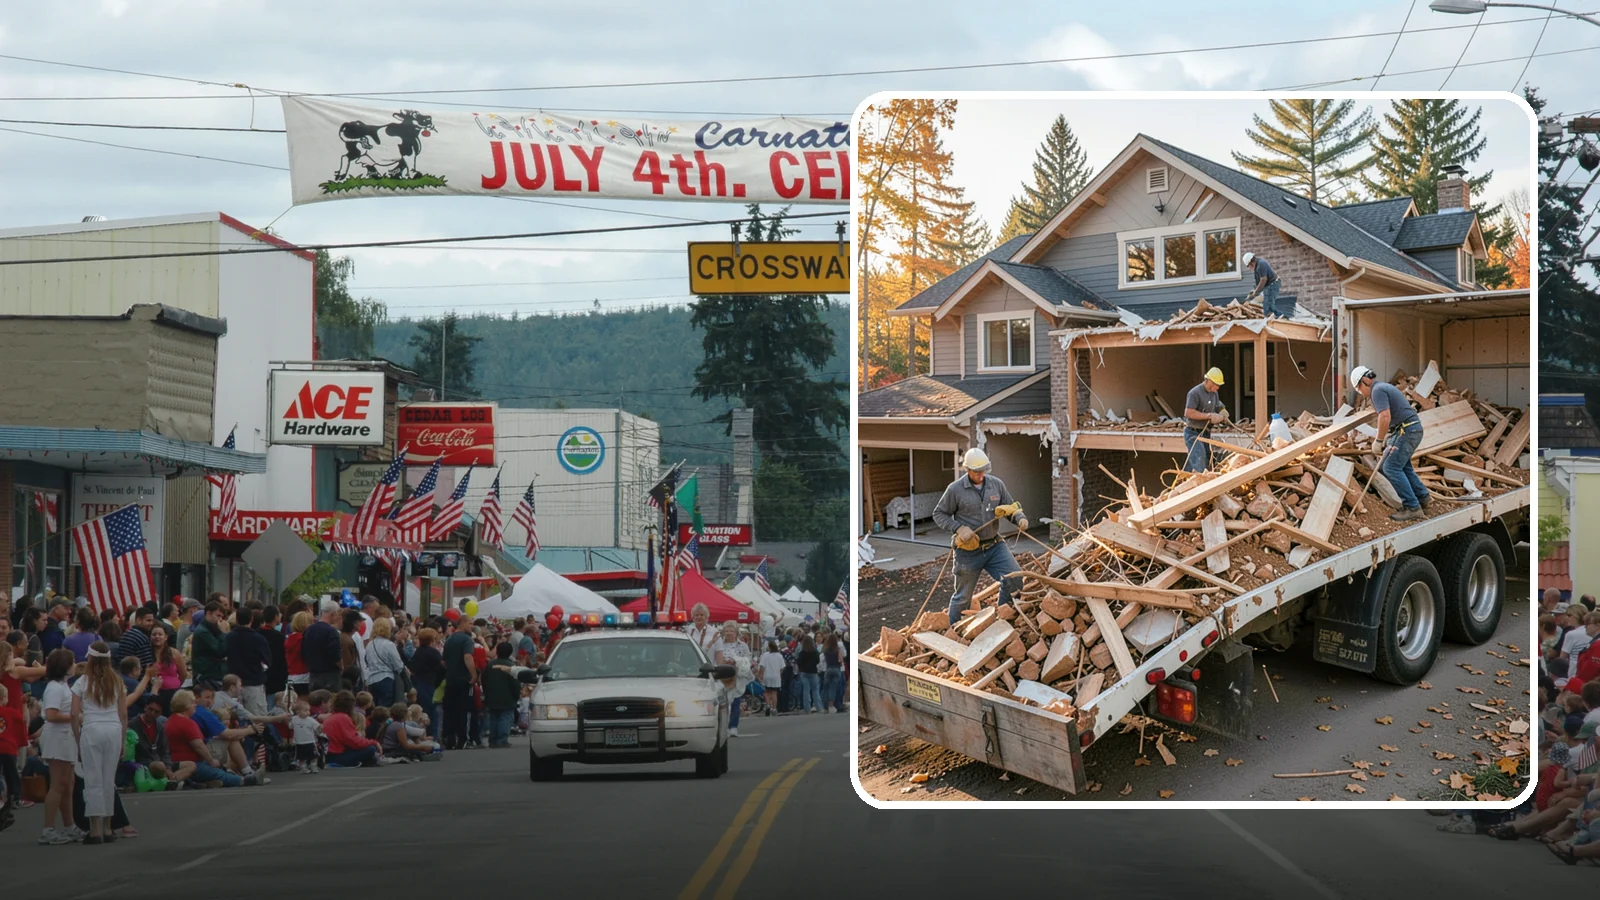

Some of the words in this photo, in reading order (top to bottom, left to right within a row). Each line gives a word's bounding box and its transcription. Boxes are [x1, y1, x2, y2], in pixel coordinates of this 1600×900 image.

[695, 121, 850, 150] Carnat
[481, 141, 604, 193] JULY
[633, 149, 746, 198] 4th.
[696, 253, 850, 280] CROSSWA
[283, 380, 373, 420] ACE
[406, 409, 452, 422] CEDAR
[283, 421, 371, 436] Hardware
[416, 428, 477, 447] Coca-Cola
[353, 467, 385, 479] Simpl
[83, 485, 94, 494] St.
[95, 485, 124, 495] Vincent
[126, 486, 136, 495] de
[137, 486, 155, 495] Paul
[688, 526, 741, 535] CRNATION
[699, 535, 730, 543] GLASS
